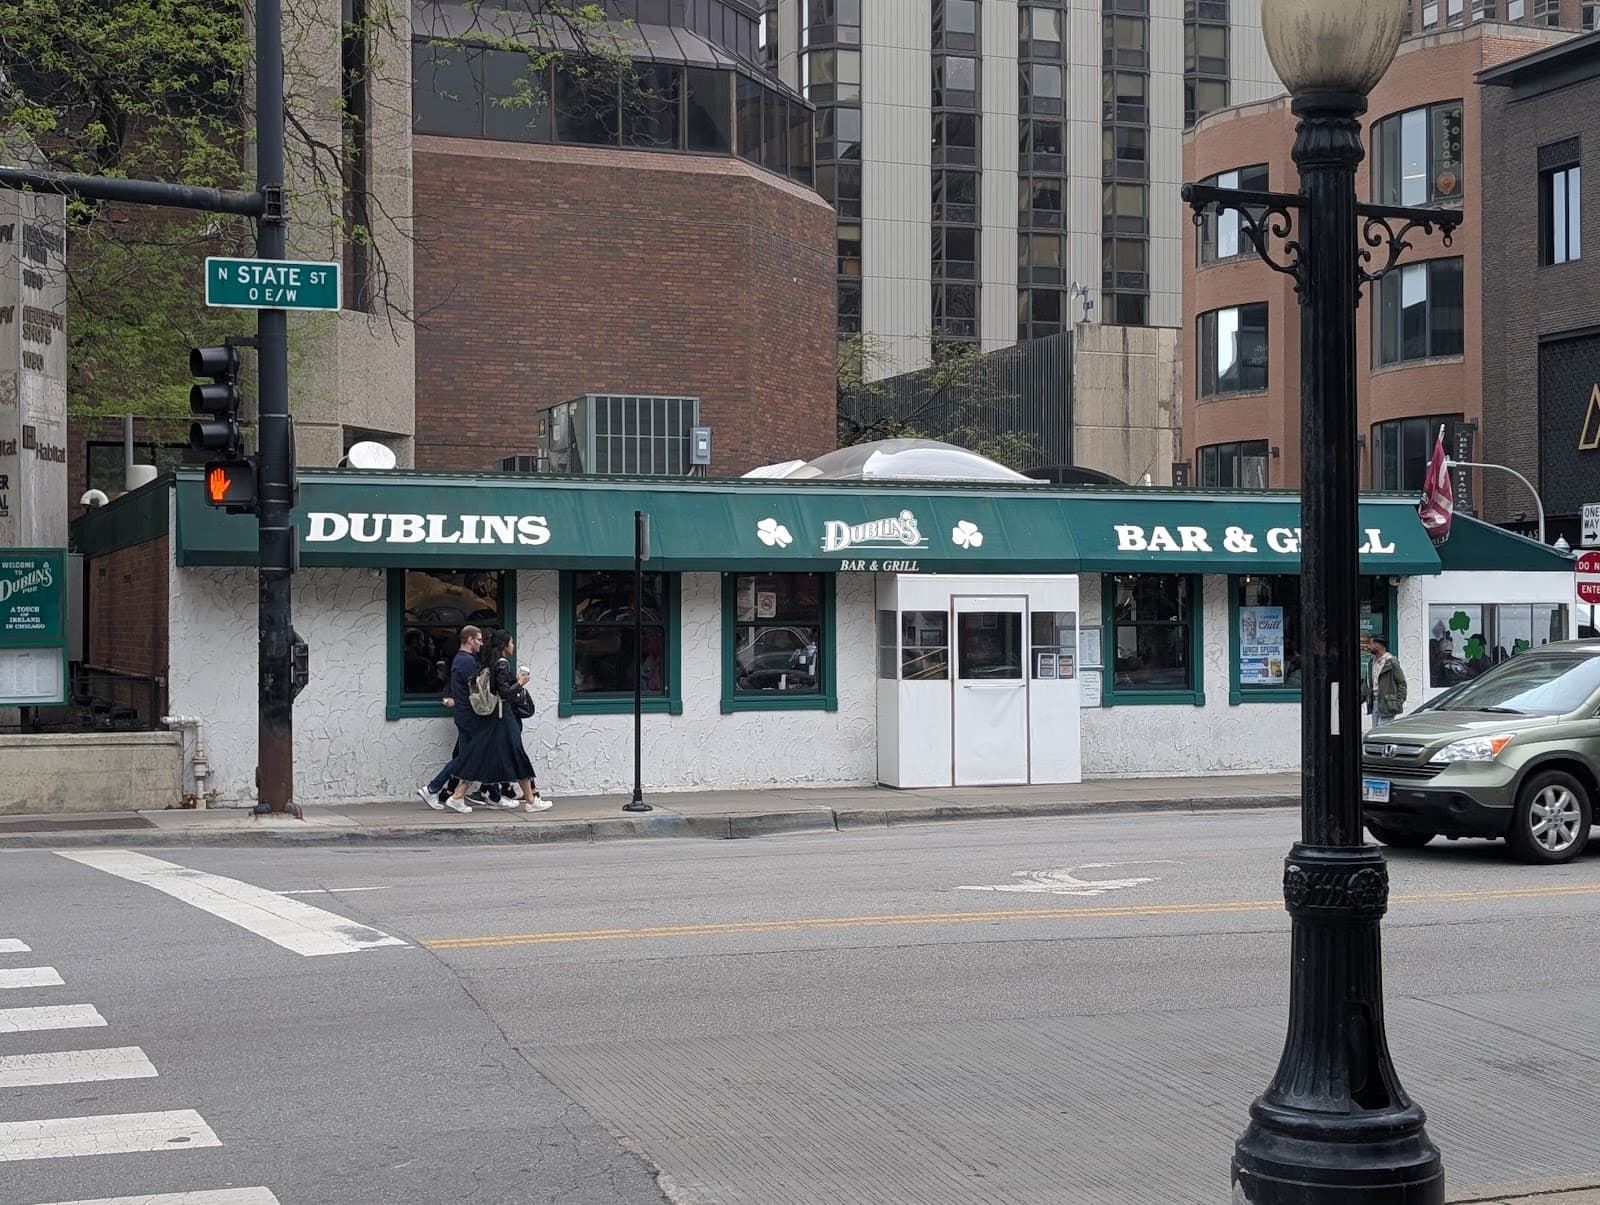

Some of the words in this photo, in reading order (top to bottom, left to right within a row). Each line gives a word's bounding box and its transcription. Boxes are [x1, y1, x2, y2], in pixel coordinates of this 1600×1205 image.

[218, 267, 228, 280] N
[237, 265, 301, 286] STATE
[309, 271, 327, 285] ST
[265, 288, 297, 302] E/W
[1459, 436, 1468, 464] BELL
[1584, 507, 1600, 518] ONE
[305, 511, 551, 546] DUBLINS
[1584, 518, 1600, 529] WAY
[1113, 524, 1213, 552] BAR
[1223, 525, 1258, 552] &
[840, 560, 866, 571] BAR
[869, 560, 879, 571] &
[883, 560, 919, 571] GRILL
[1578, 561, 1590, 570] DO
